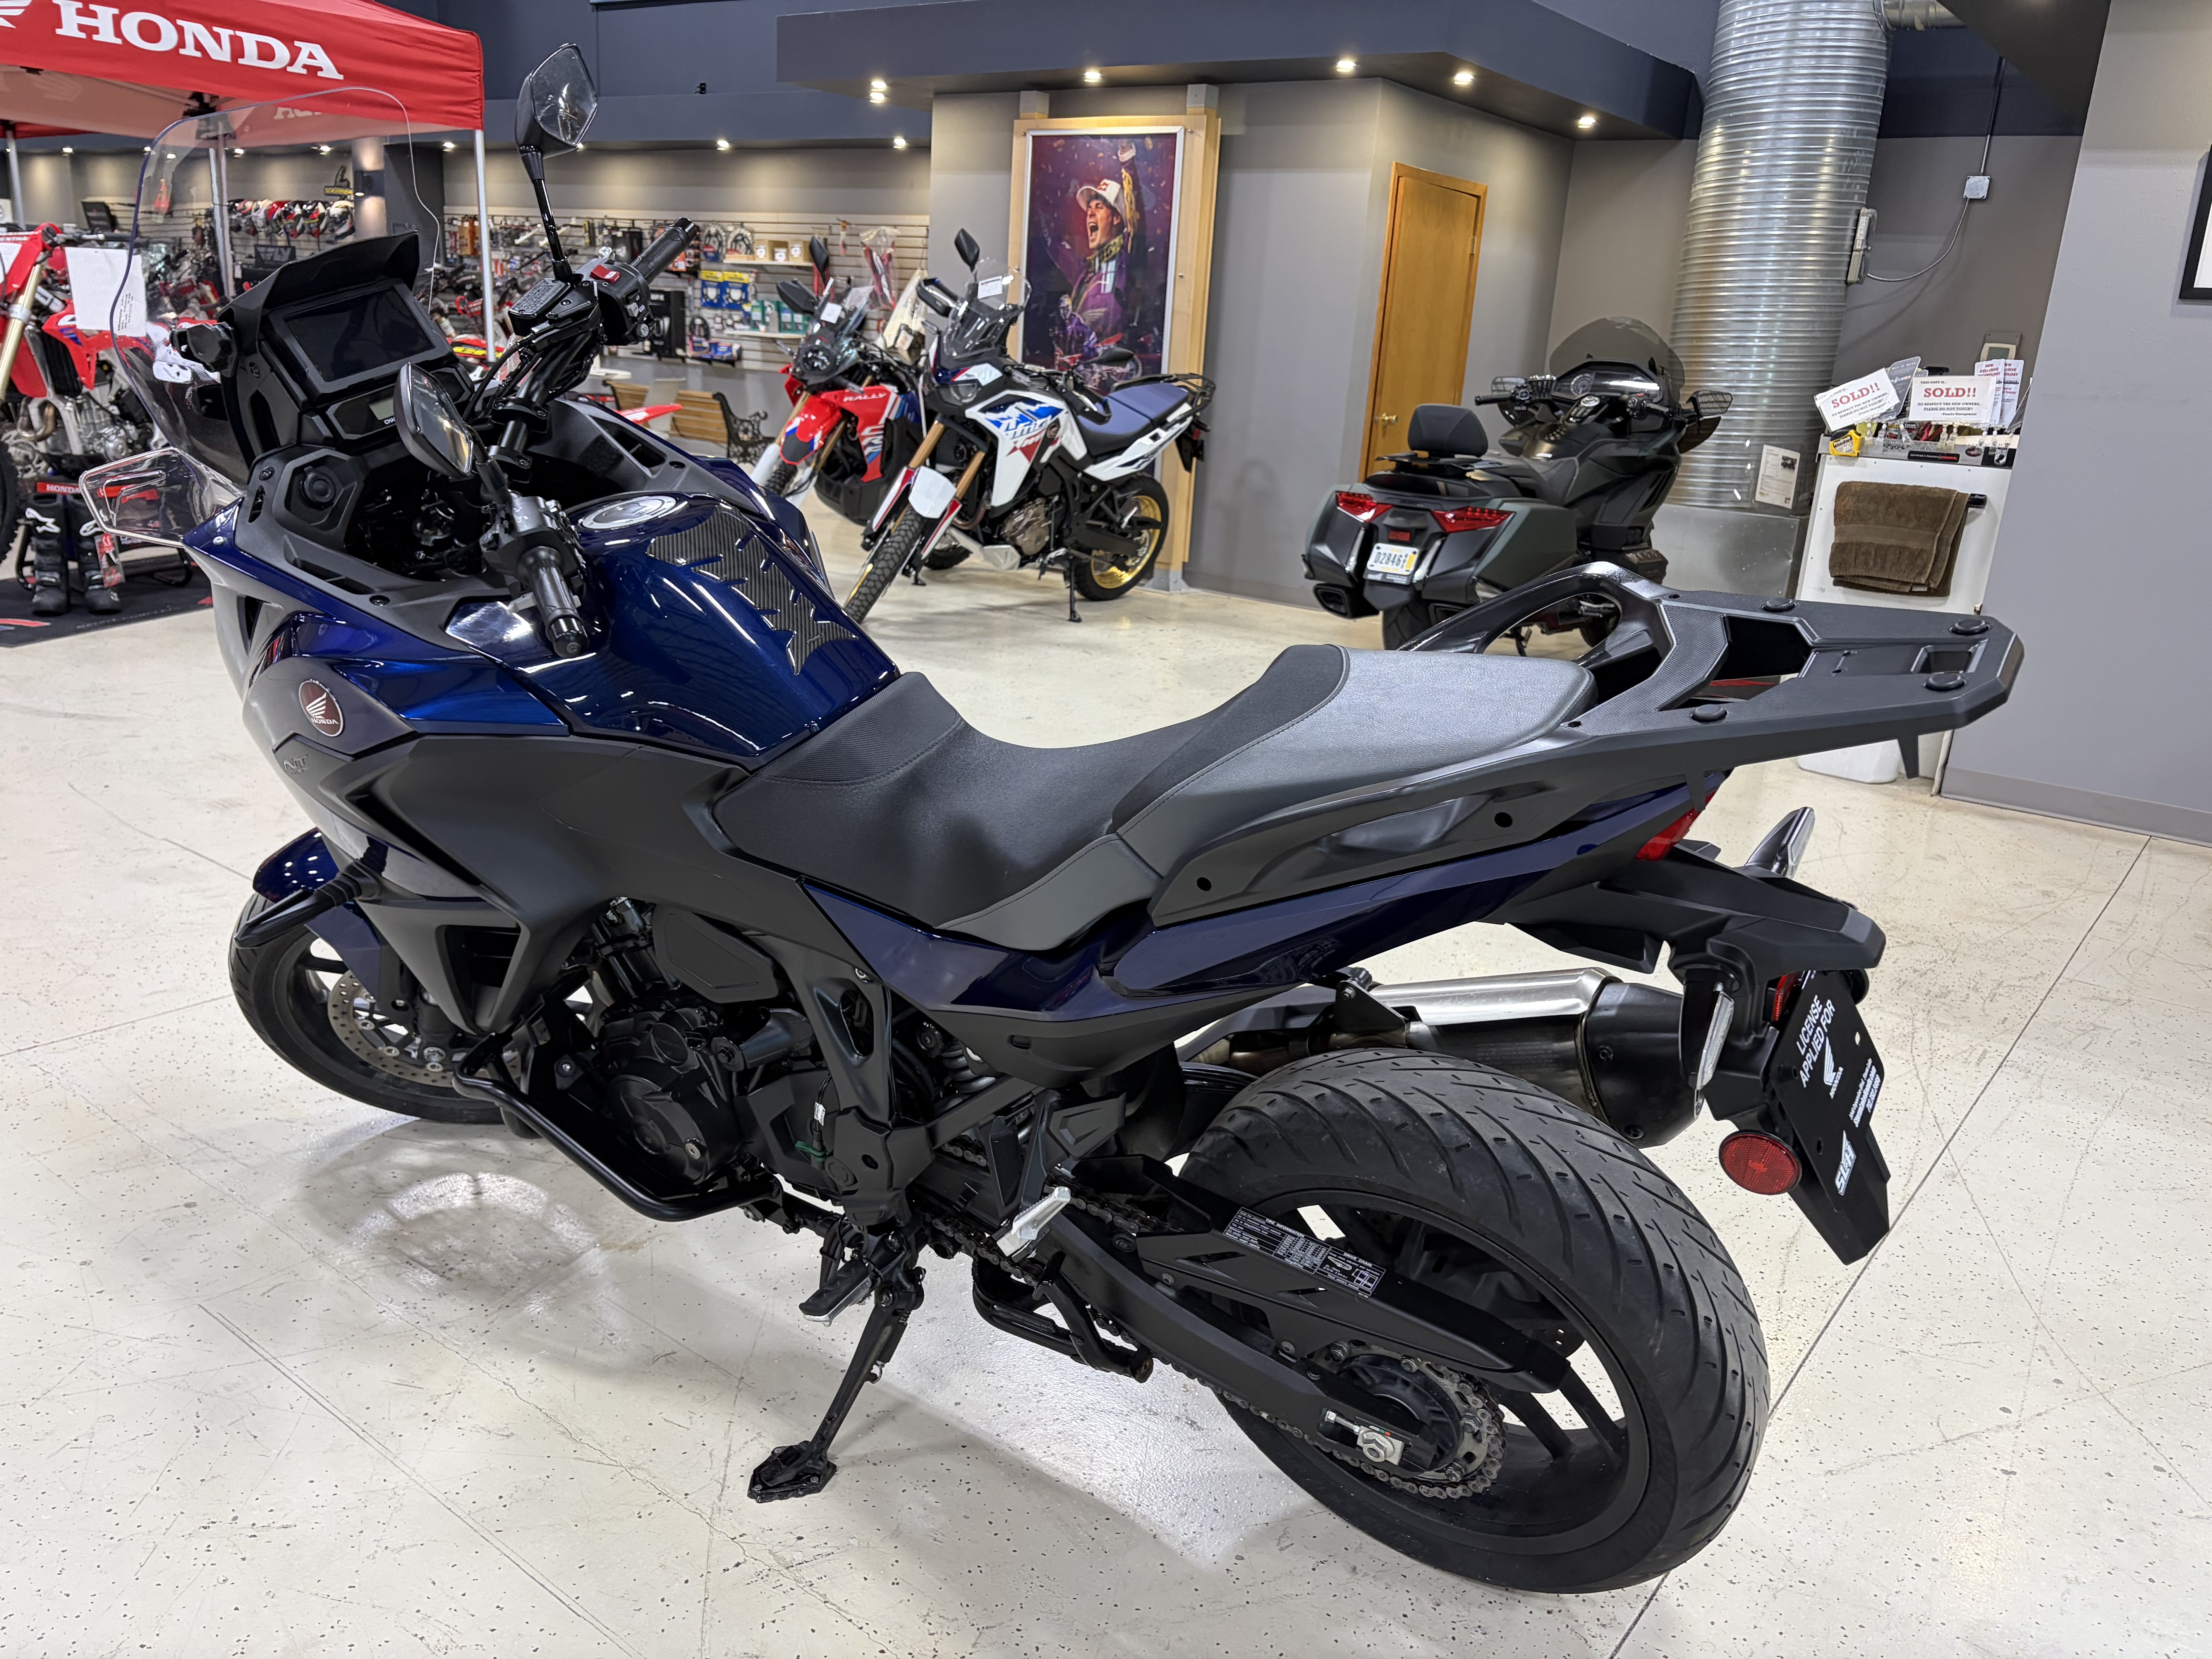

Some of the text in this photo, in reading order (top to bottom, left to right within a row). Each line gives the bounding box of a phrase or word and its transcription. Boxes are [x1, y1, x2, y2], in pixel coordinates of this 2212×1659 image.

[54, 0, 344, 80] HONDA
[843, 393, 887, 402] RALLY
[1831, 382, 1880, 409] SOLD!!
[1923, 388, 1977, 398] SOLD!!
[46, 484, 81, 494] HONDA
[283, 754, 308, 772] NT
[1796, 994, 1822, 1055] LICENSE
[1800, 999, 1835, 1088] APPLIED FOR
[1829, 1066, 1844, 1099] HONDA
[1276, 1222, 1305, 1238] INFORMATION
[1343, 1252, 1373, 1267] DRIVE CHAIN
